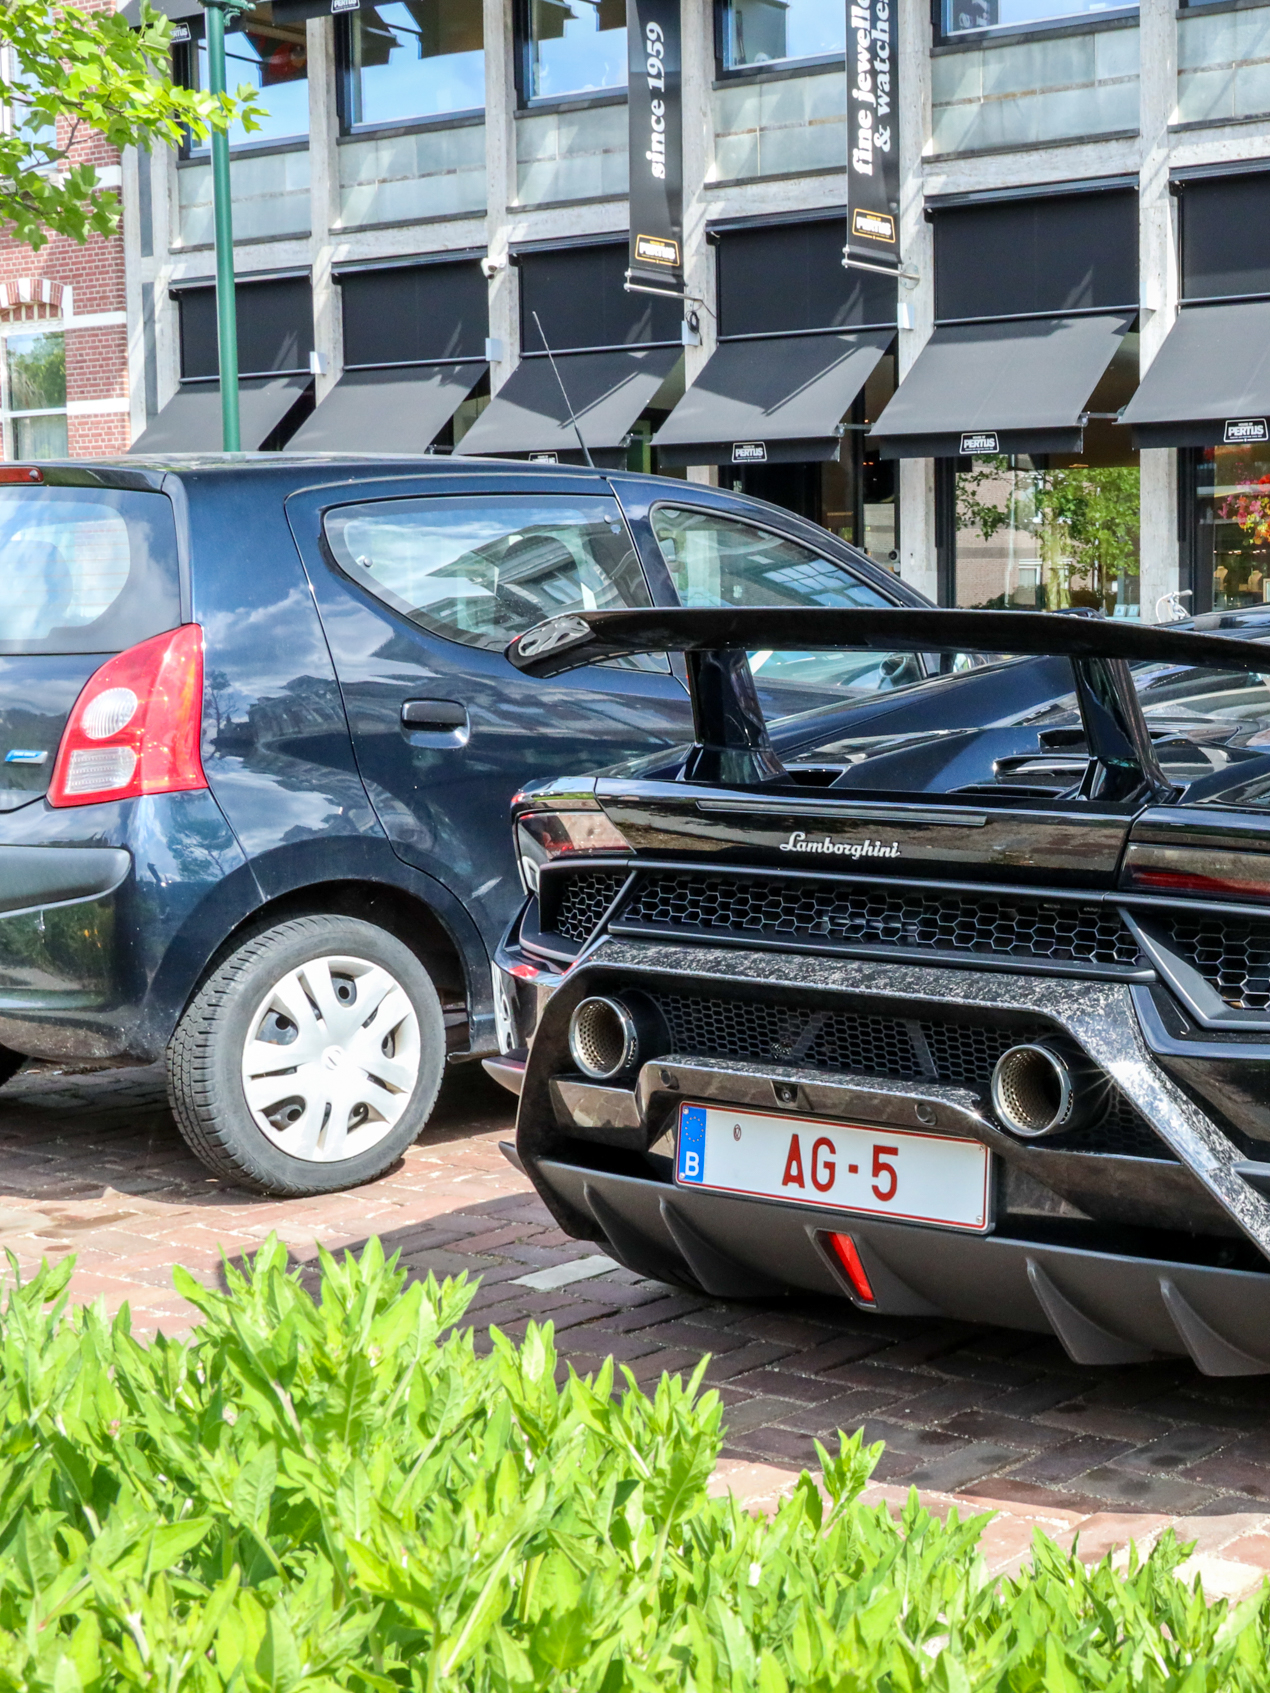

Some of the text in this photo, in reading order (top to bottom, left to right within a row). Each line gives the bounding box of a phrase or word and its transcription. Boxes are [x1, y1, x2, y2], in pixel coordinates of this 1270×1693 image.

[646, 21, 665, 179] since 1959
[871, 0, 891, 153] & watche
[852, 109, 873, 176] fine
[779, 831, 901, 860] Lamborghini
[684, 1151, 700, 1177] B
[781, 1133, 899, 1202] AG-5
